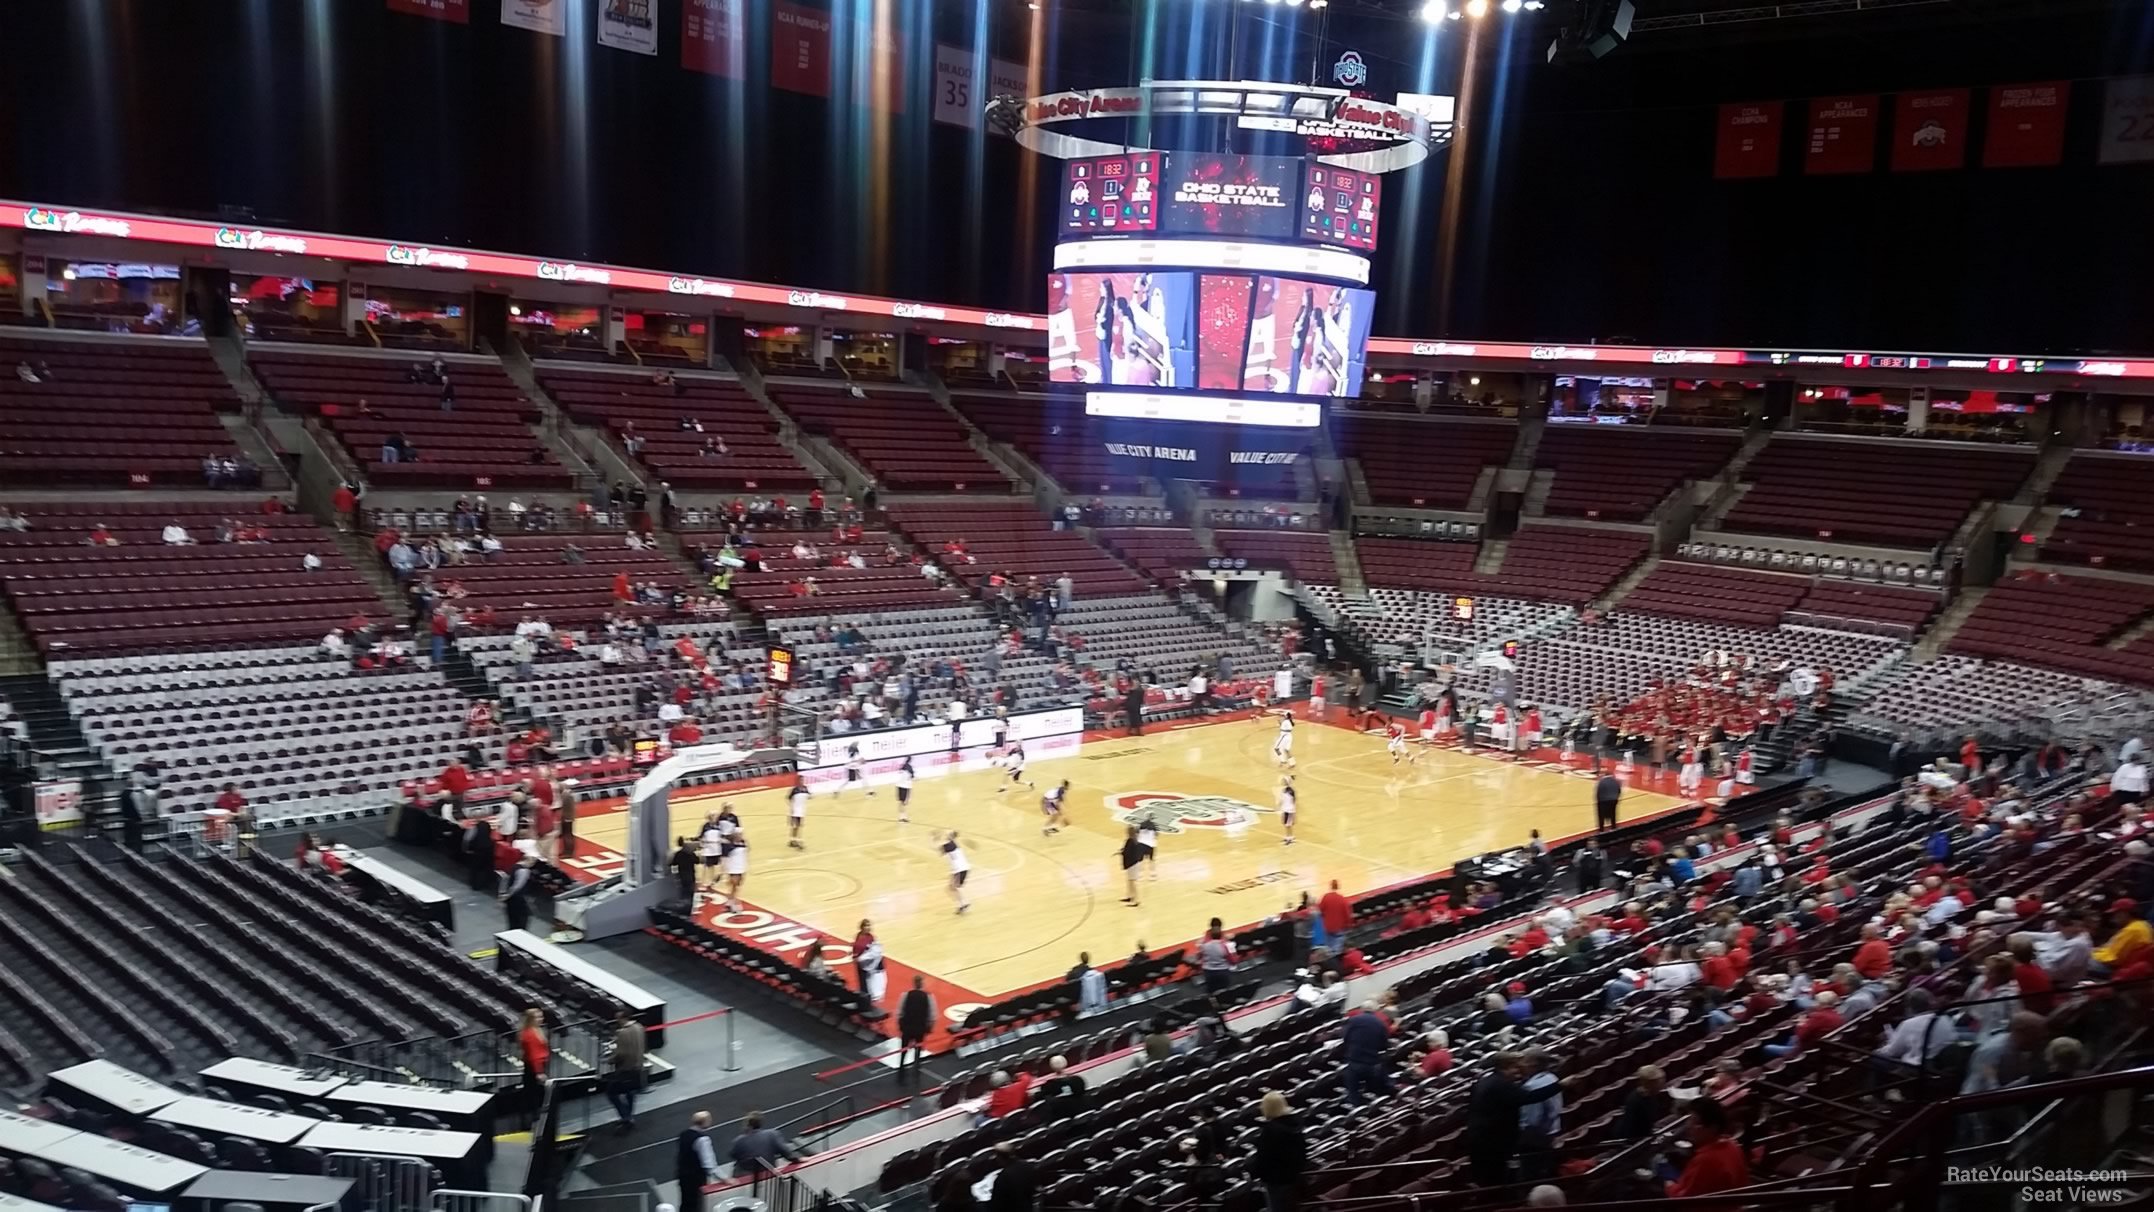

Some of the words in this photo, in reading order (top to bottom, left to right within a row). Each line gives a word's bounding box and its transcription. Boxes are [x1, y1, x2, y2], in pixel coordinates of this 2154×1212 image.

[945, 80, 968, 107] 35
[1058, 97, 1090, 119] City
[1090, 96, 1142, 113] Arena
[1336, 102, 1382, 125] Value
[1819, 108, 1869, 119] APPEARANCES
[1297, 125, 1393, 141] BASKETBALL
[1183, 182, 1220, 194] OHIO
[1223, 184, 1281, 197] STATE
[1175, 191, 1286, 207] BASKETBALL
[1127, 445, 1152, 457] CITY
[1154, 447, 1197, 461] ARENA
[1230, 452, 1268, 463] VALUE
[476, 476, 492, 485] 105
